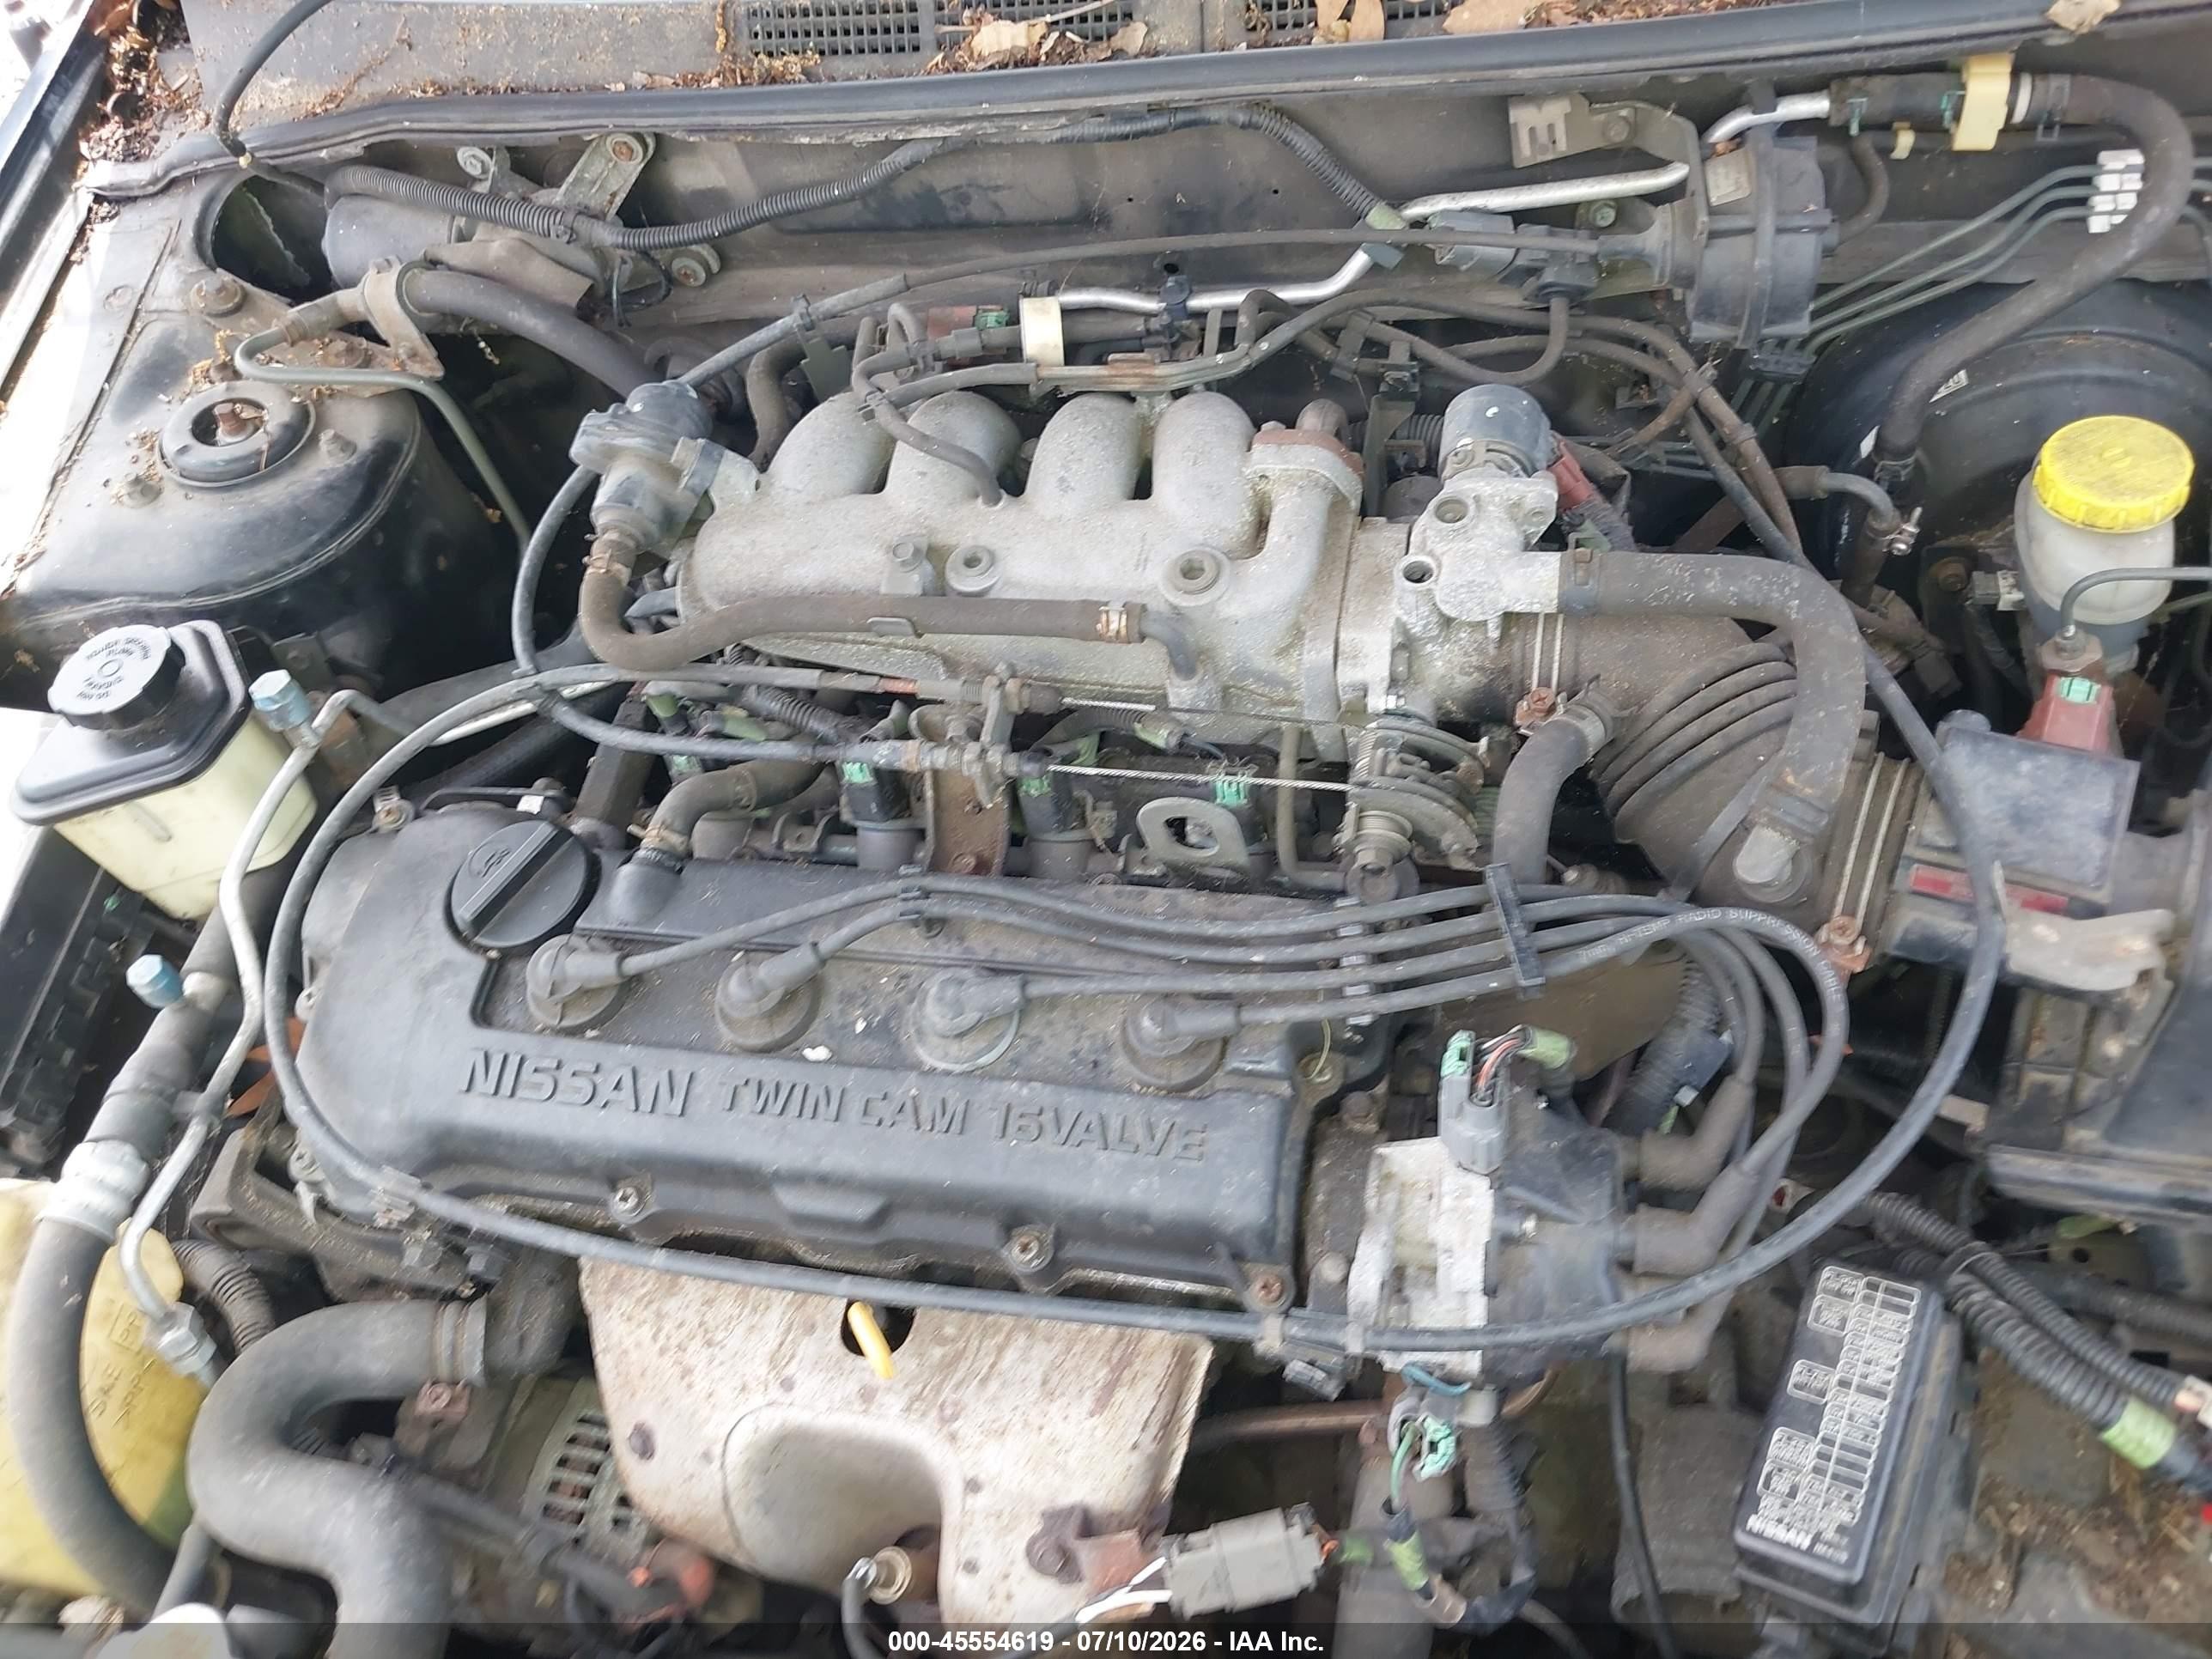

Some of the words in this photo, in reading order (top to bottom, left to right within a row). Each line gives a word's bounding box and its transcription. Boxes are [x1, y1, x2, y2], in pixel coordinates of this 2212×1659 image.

[1676, 908, 1722, 925] RADIO
[463, 1048, 694, 1117] NISSAN
[721, 1077, 847, 1126] TWIN
[860, 1091, 970, 1136] CAM
